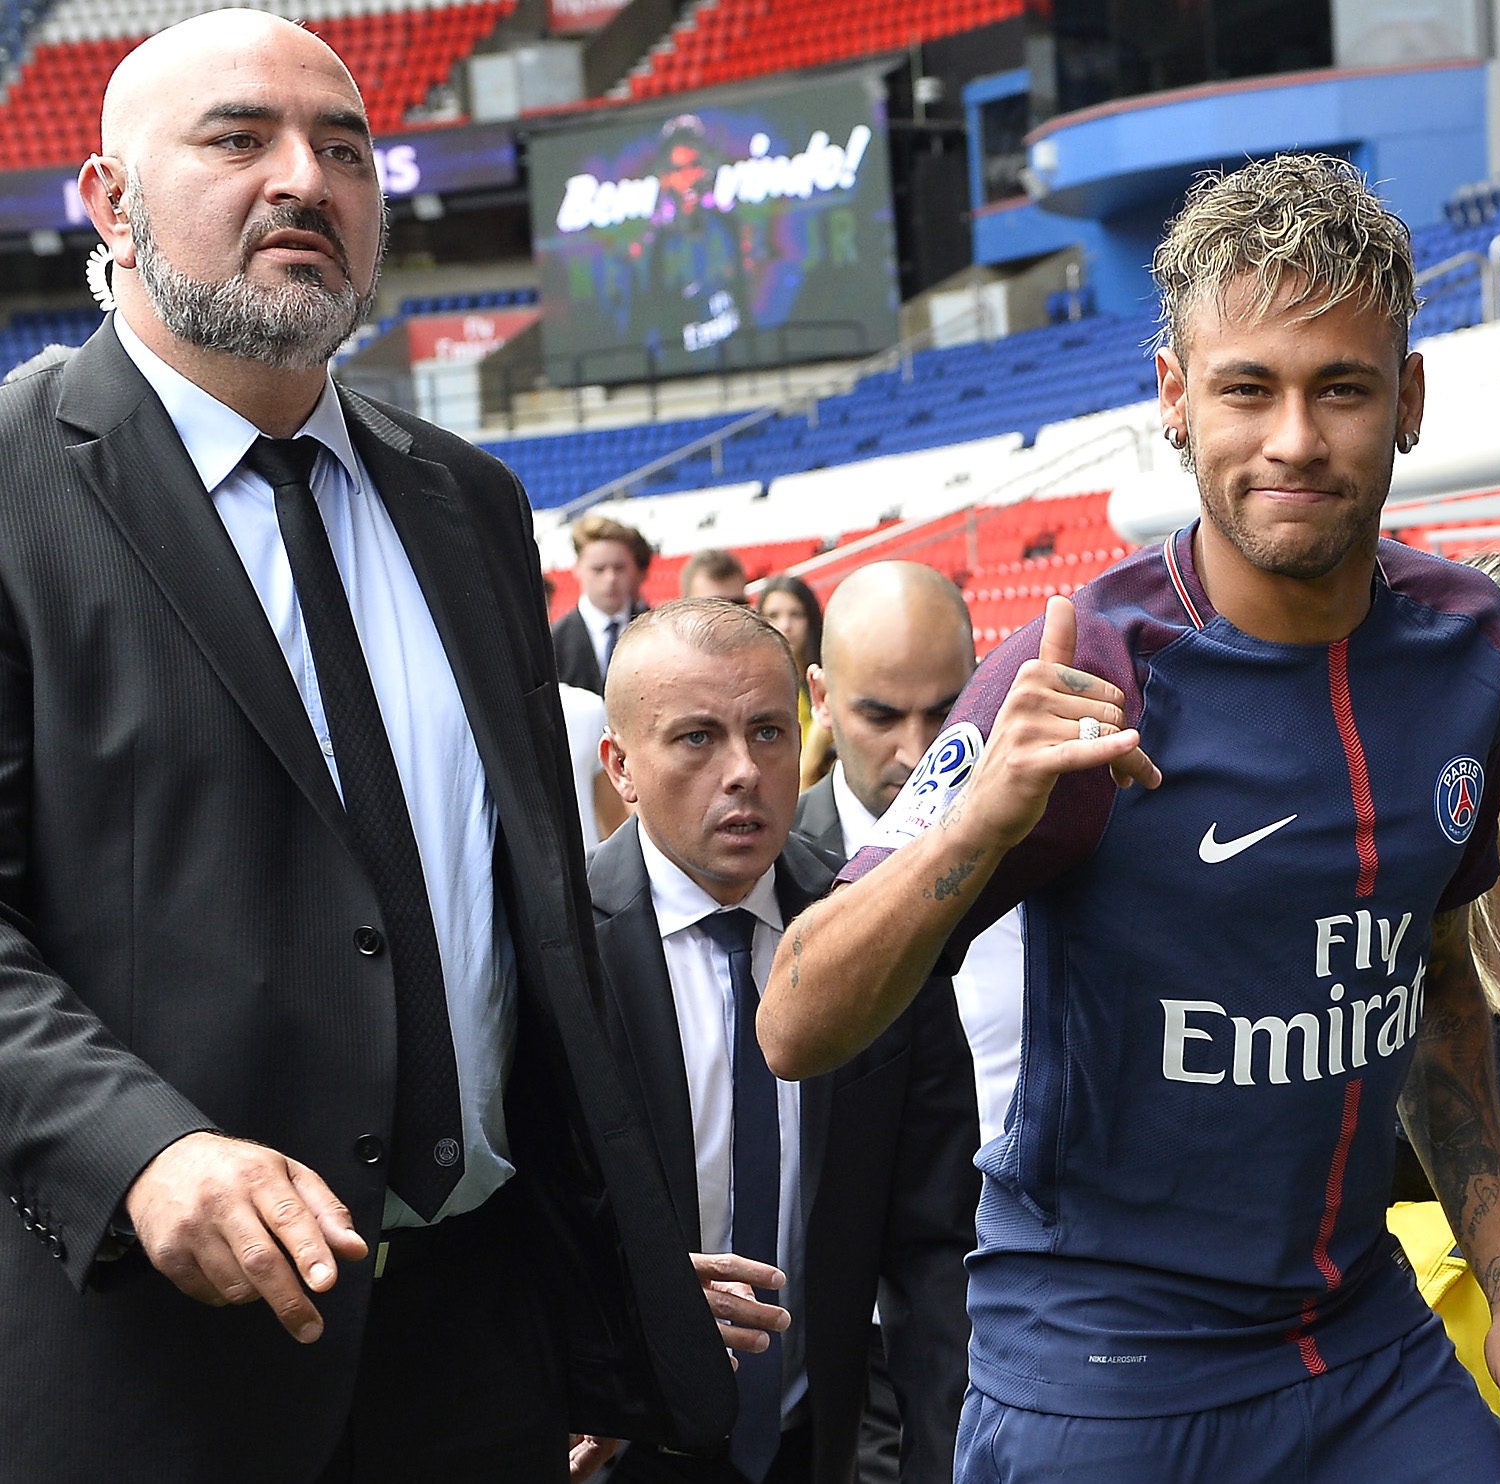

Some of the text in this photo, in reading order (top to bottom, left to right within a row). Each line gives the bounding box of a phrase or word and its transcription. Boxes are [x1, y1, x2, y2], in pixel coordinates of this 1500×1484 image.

[1443, 761, 1479, 788] PARIS
[1315, 909, 1413, 977] Fly
[1159, 955, 1427, 1086] Emirat
[1088, 1355, 1147, 1363] NIKE AEROSWIFT
